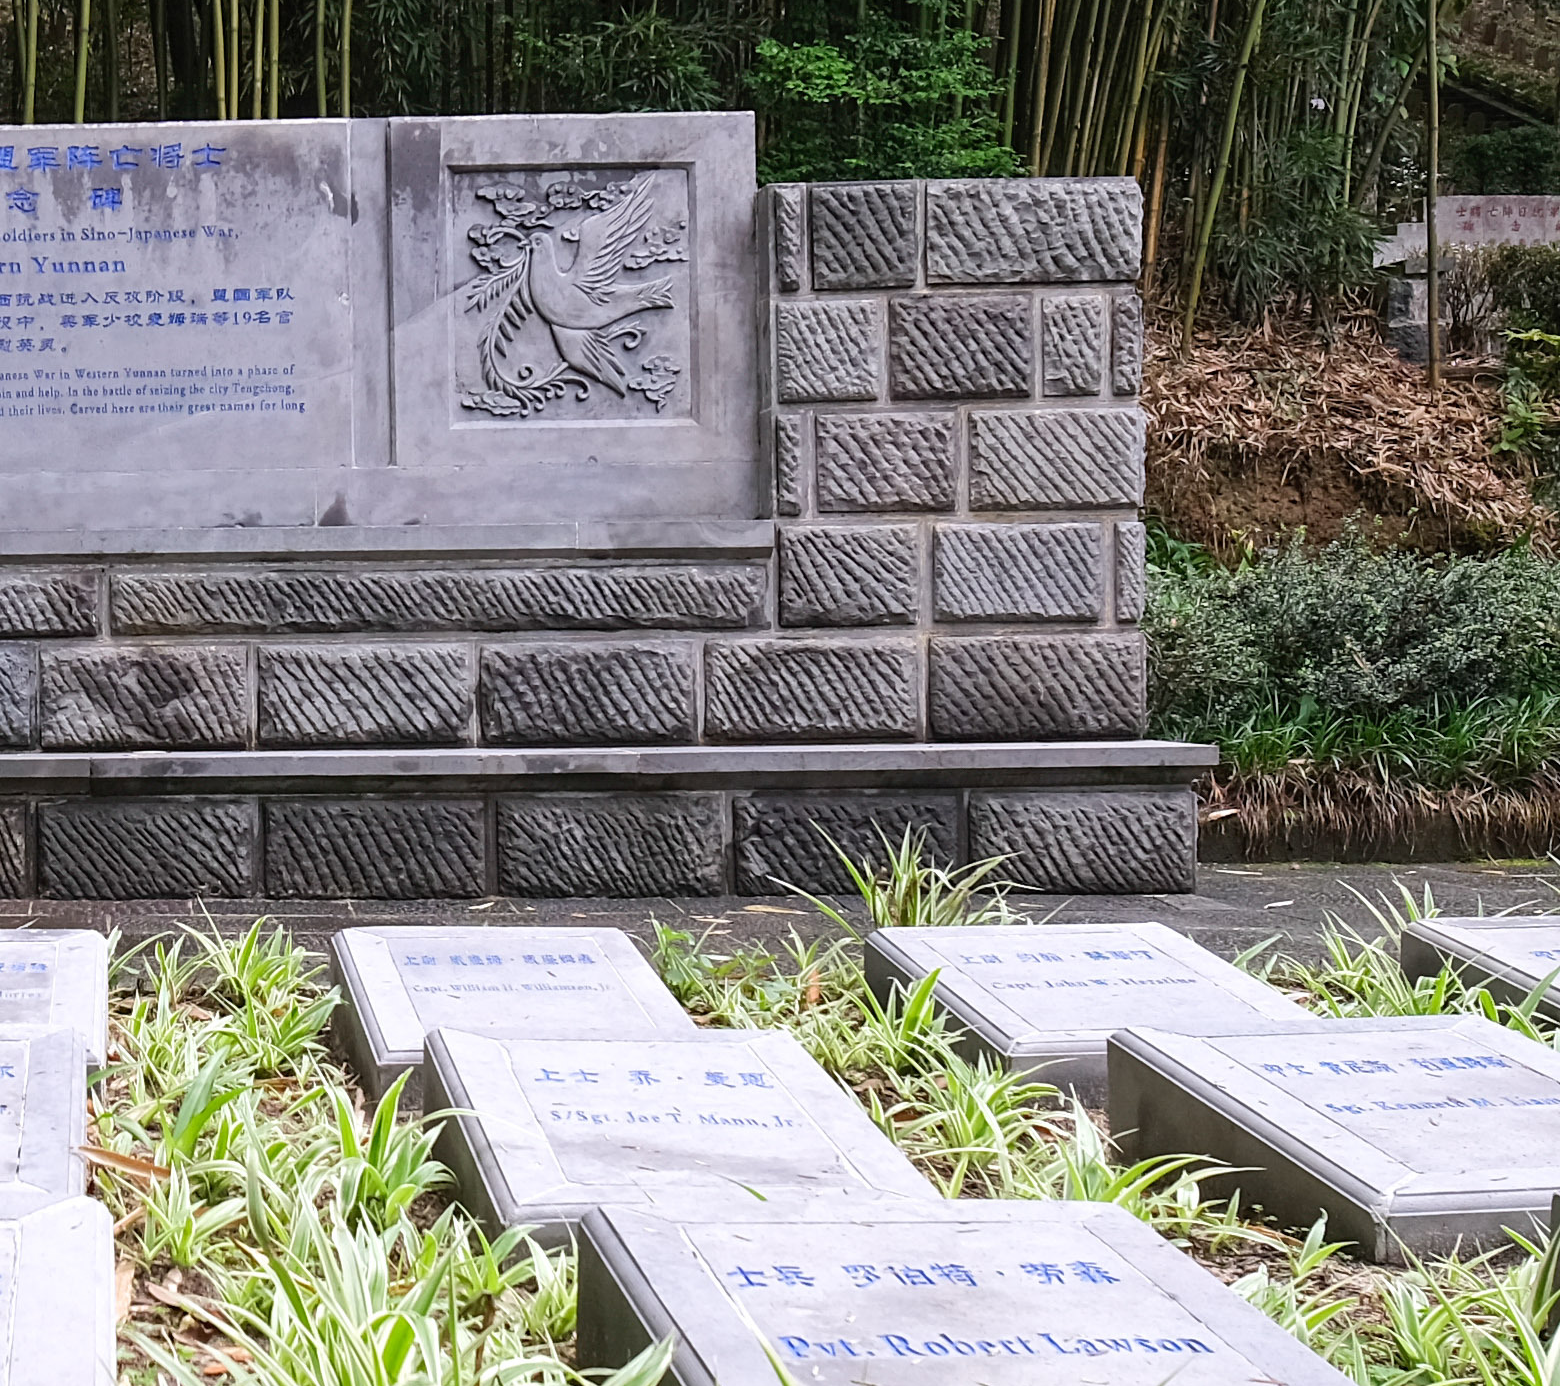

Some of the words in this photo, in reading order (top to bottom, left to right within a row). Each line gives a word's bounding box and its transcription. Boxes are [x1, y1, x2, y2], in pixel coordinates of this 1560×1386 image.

[61, 228, 76, 241] in
[30, 256, 127, 273] Yunnan
[33, 369, 55, 380] War
[59, 368, 70, 380] in
[75, 368, 119, 380] Western
[123, 367, 166, 378] Yunnan
[170, 365, 207, 377] turned
[211, 365, 233, 377] into
[237, 368, 243, 376] a
[282, 363, 295, 375] of
[15, 387, 34, 398] and
[83, 386, 99, 396] the
[102, 385, 132, 396] battle
[136, 384, 147, 395] of
[189, 383, 206, 394] the
[8, 405, 33, 416] their
[70, 403, 108, 415] Carved
[111, 403, 135, 414] here
[158, 401, 183, 412] their
[188, 402, 216, 415] great
[260, 399, 276, 411] for
[280, 399, 306, 413] long
[534, 1068, 599, 1084] 上士
[626, 1111, 661, 1124] Joe
[725, 1264, 816, 1288] 士兵
[776, 1334, 876, 1359] Pvt.
[876, 1332, 1042, 1357] Robert
[1035, 1331, 1216, 1357] Lawson
